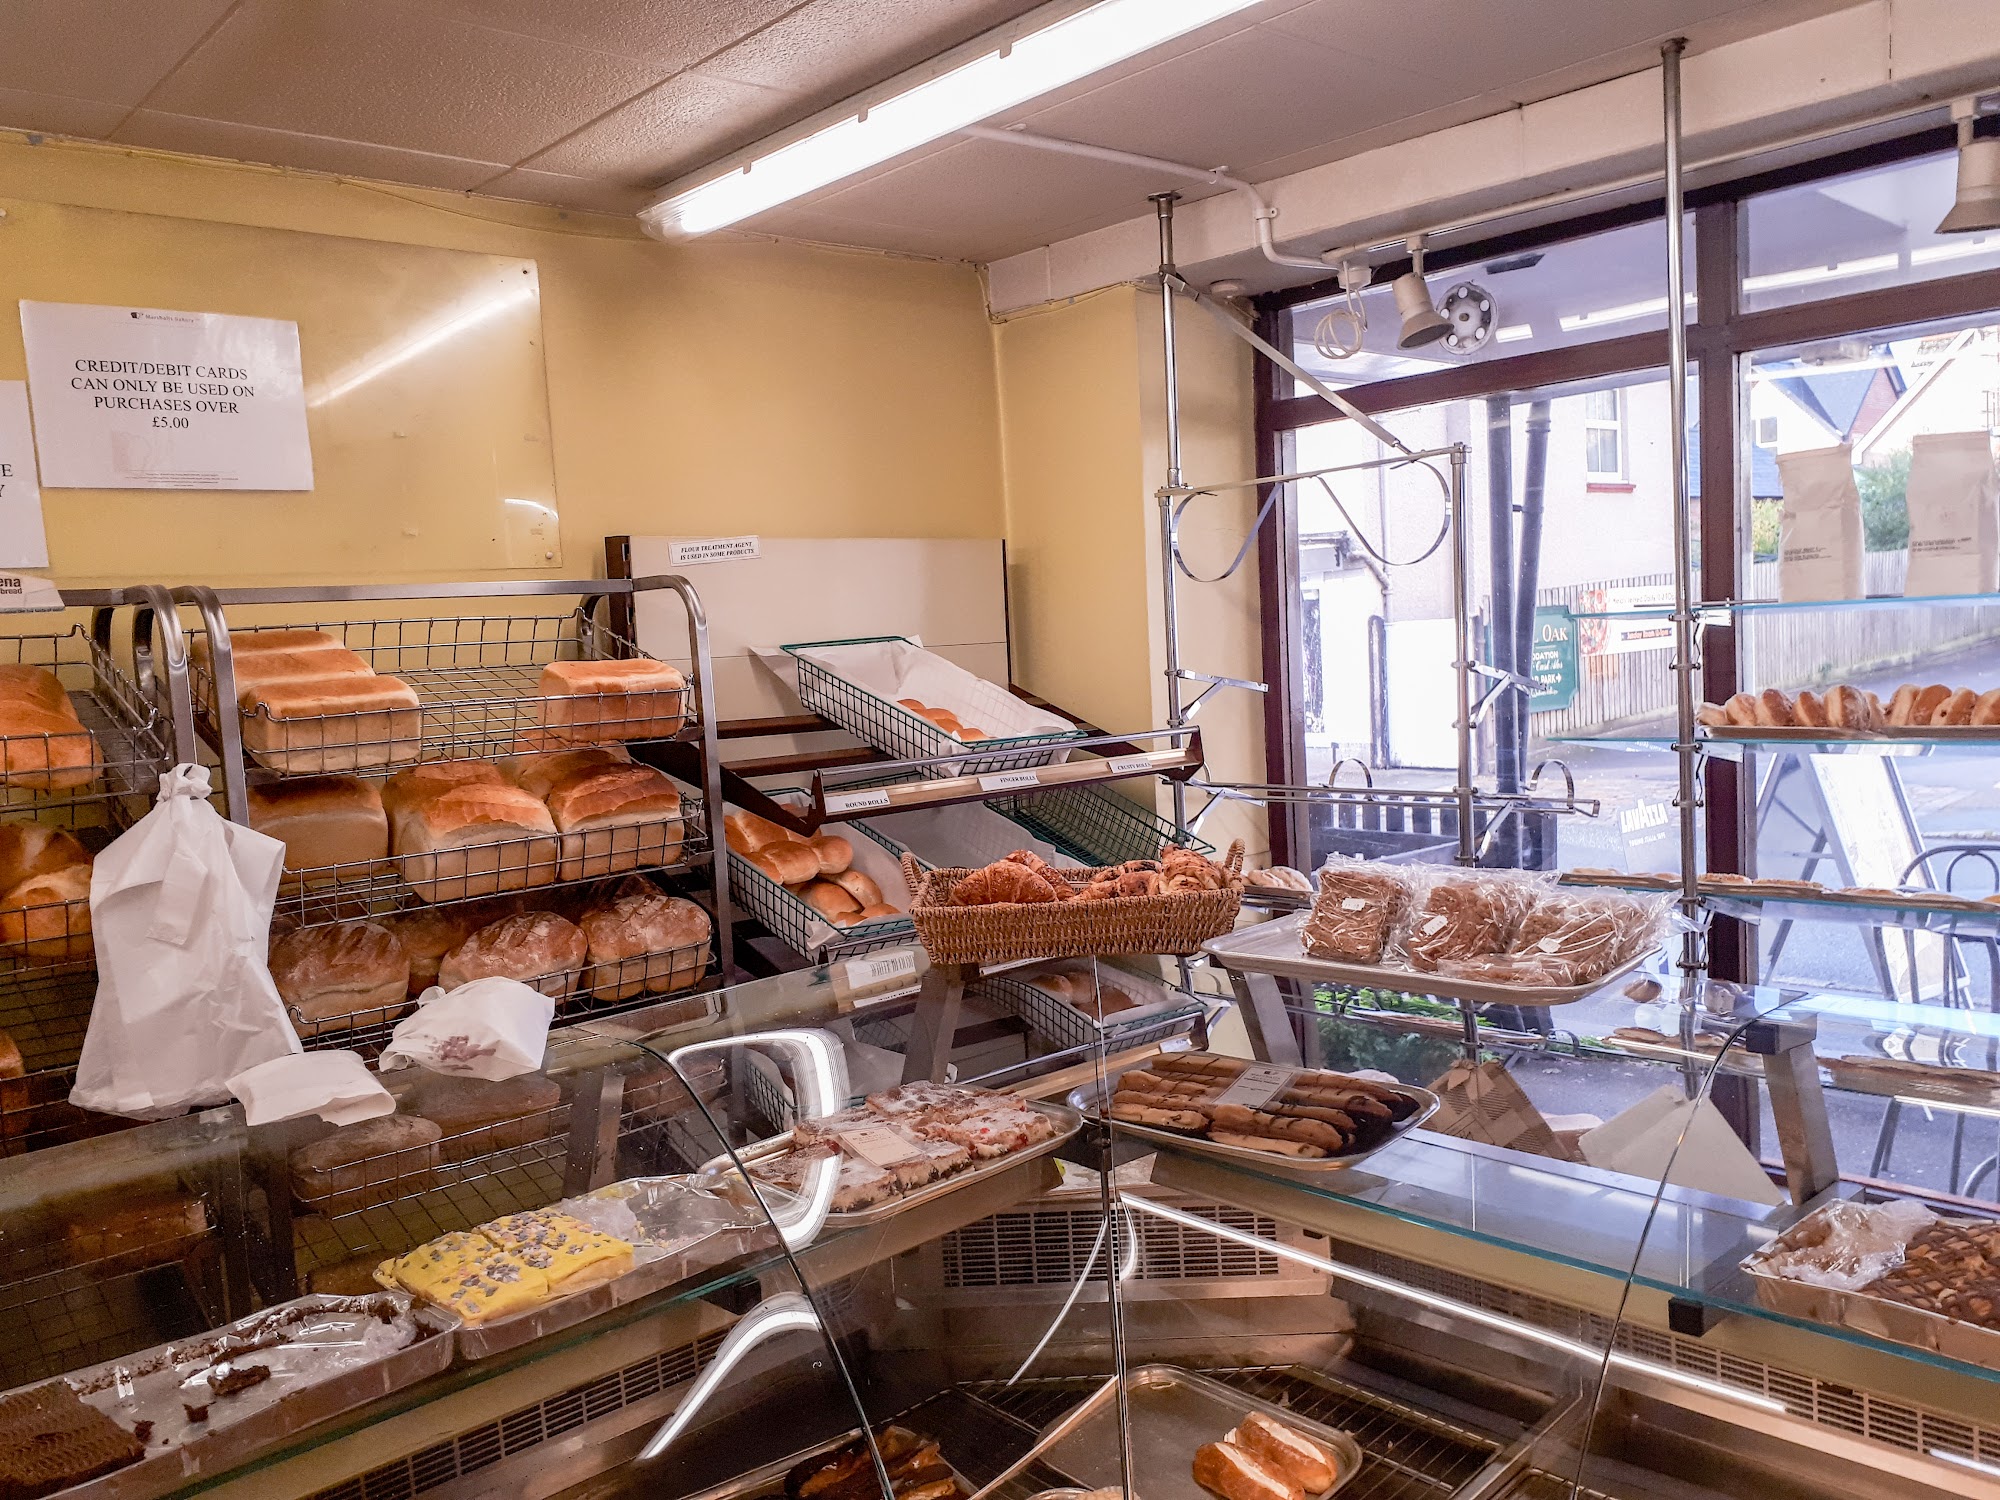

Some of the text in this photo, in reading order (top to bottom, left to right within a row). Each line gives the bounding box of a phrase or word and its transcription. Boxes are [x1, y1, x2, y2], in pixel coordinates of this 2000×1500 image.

[75, 359, 248, 380] CREDIT/DEBIT CARDS
[71, 377, 255, 398] CAN ONLY BE USED ON
[94, 397, 239, 414] PURCHASES OVER
[152, 416, 189, 429] £5.00
[726, 548, 754, 556] PRODUCTS
[1, 587, 22, 595] bread
[1540, 674, 1556, 684] PARK
[844, 798, 889, 809] ROUND ROLLS
[1620, 798, 1669, 833] LAVAZZA
